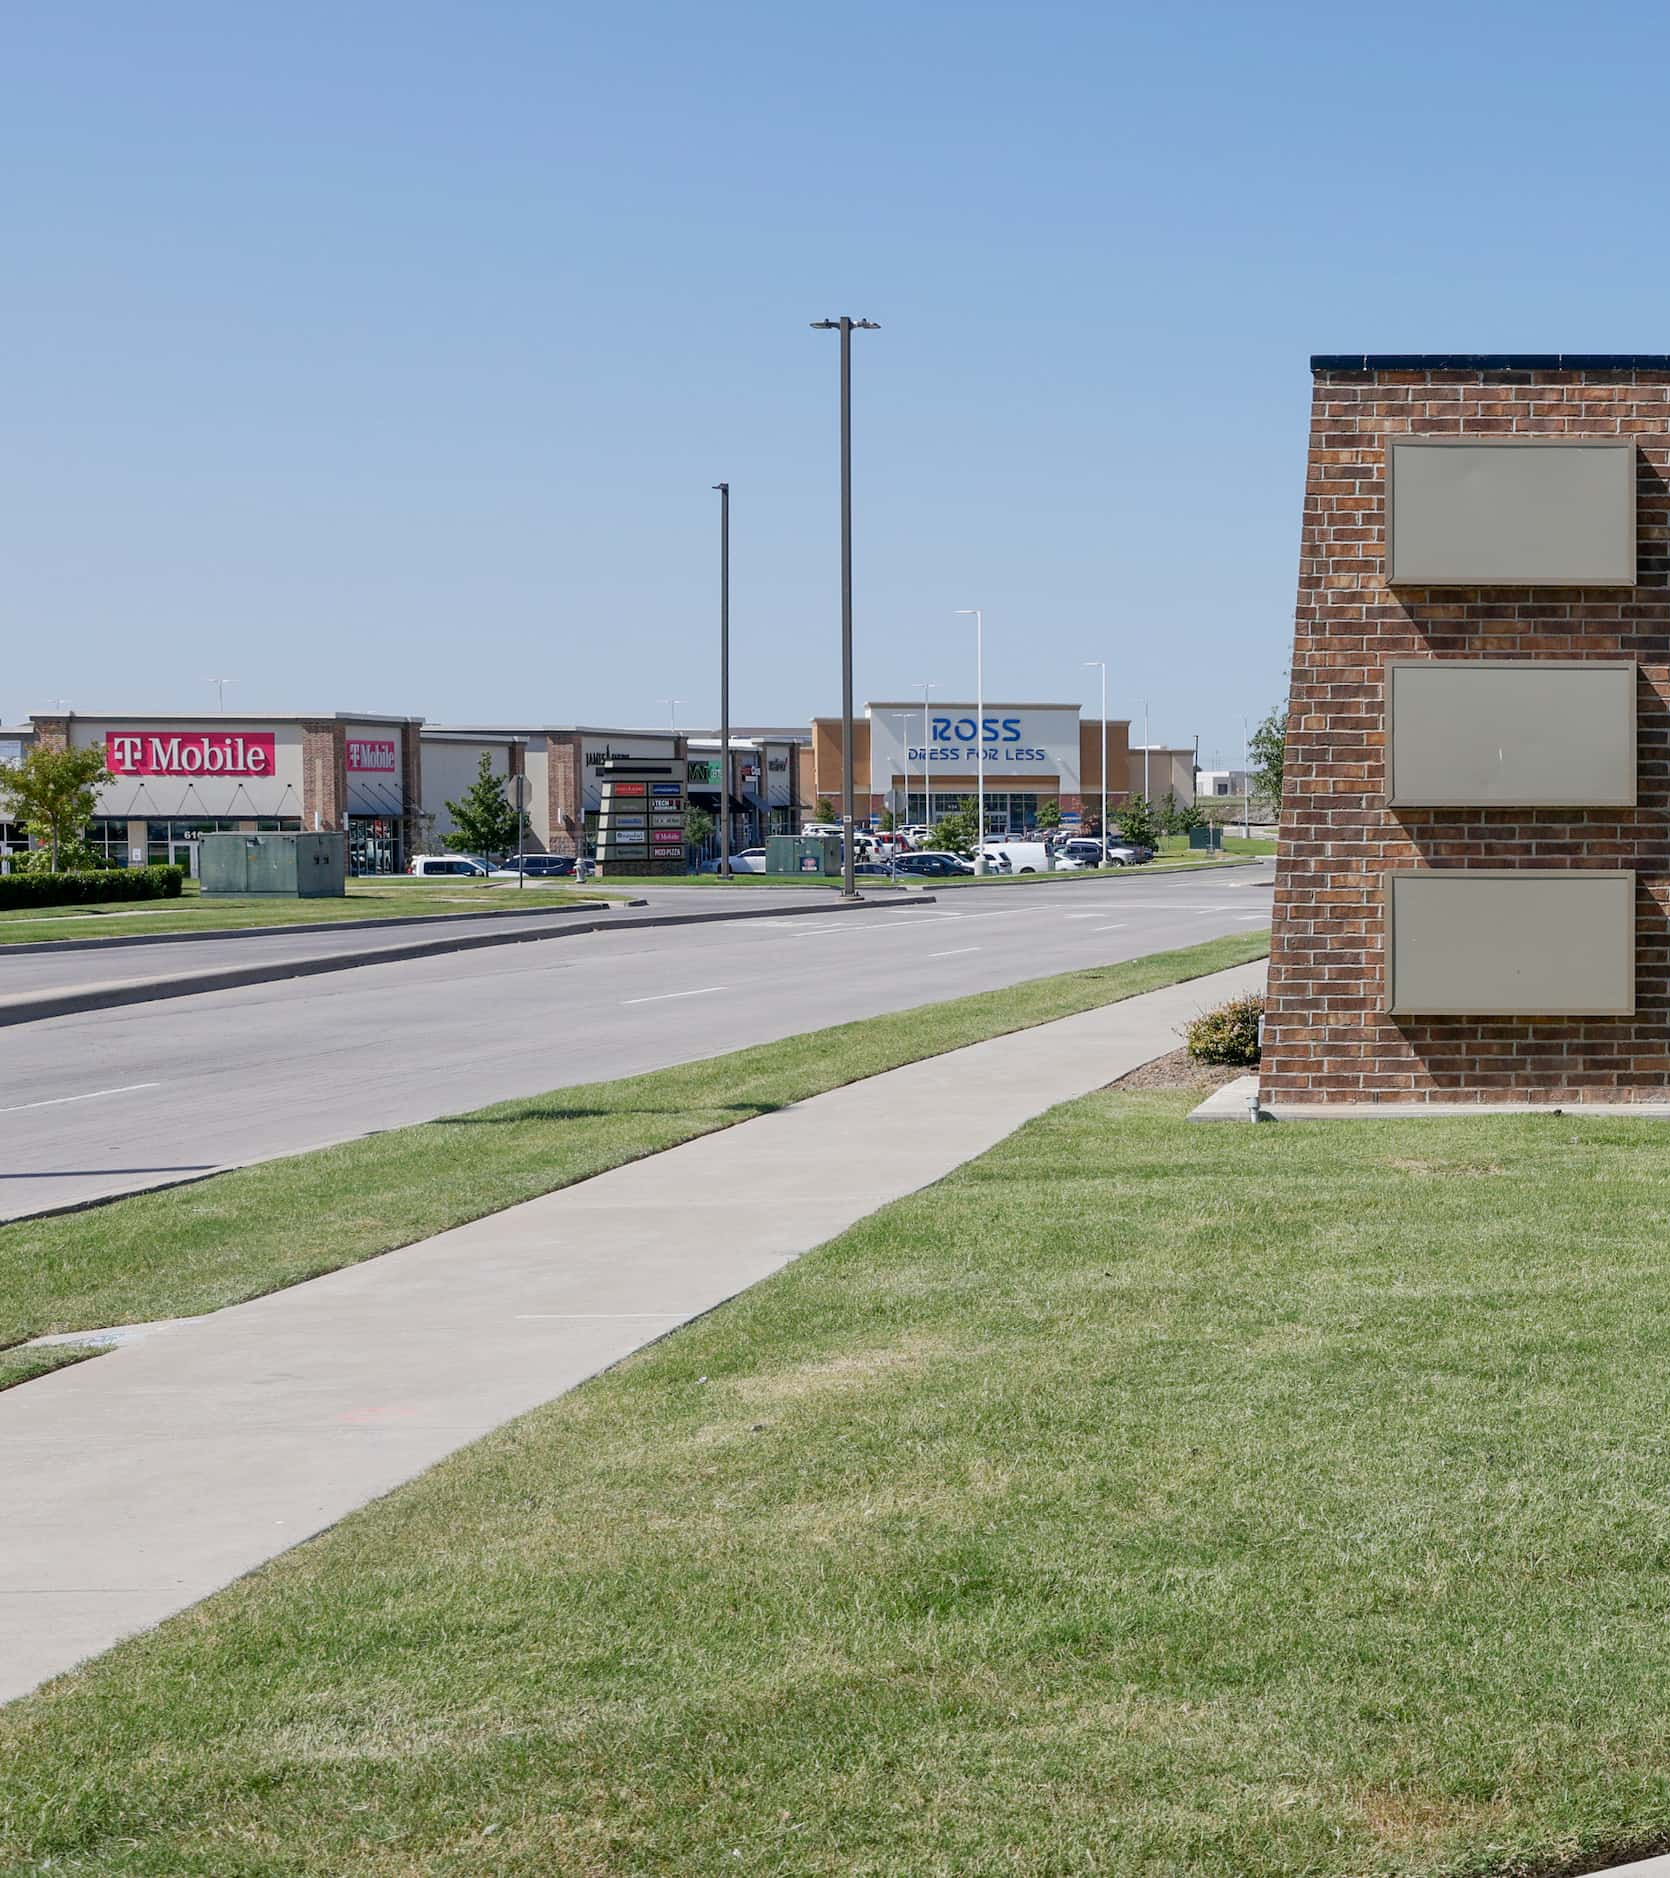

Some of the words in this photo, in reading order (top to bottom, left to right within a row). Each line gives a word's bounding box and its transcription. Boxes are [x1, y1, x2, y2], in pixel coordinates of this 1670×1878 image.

[932, 718, 1021, 742] ROSS
[908, 748, 960, 761] DRESS
[966, 748, 998, 761] FOR
[1005, 748, 1046, 761] LESS
